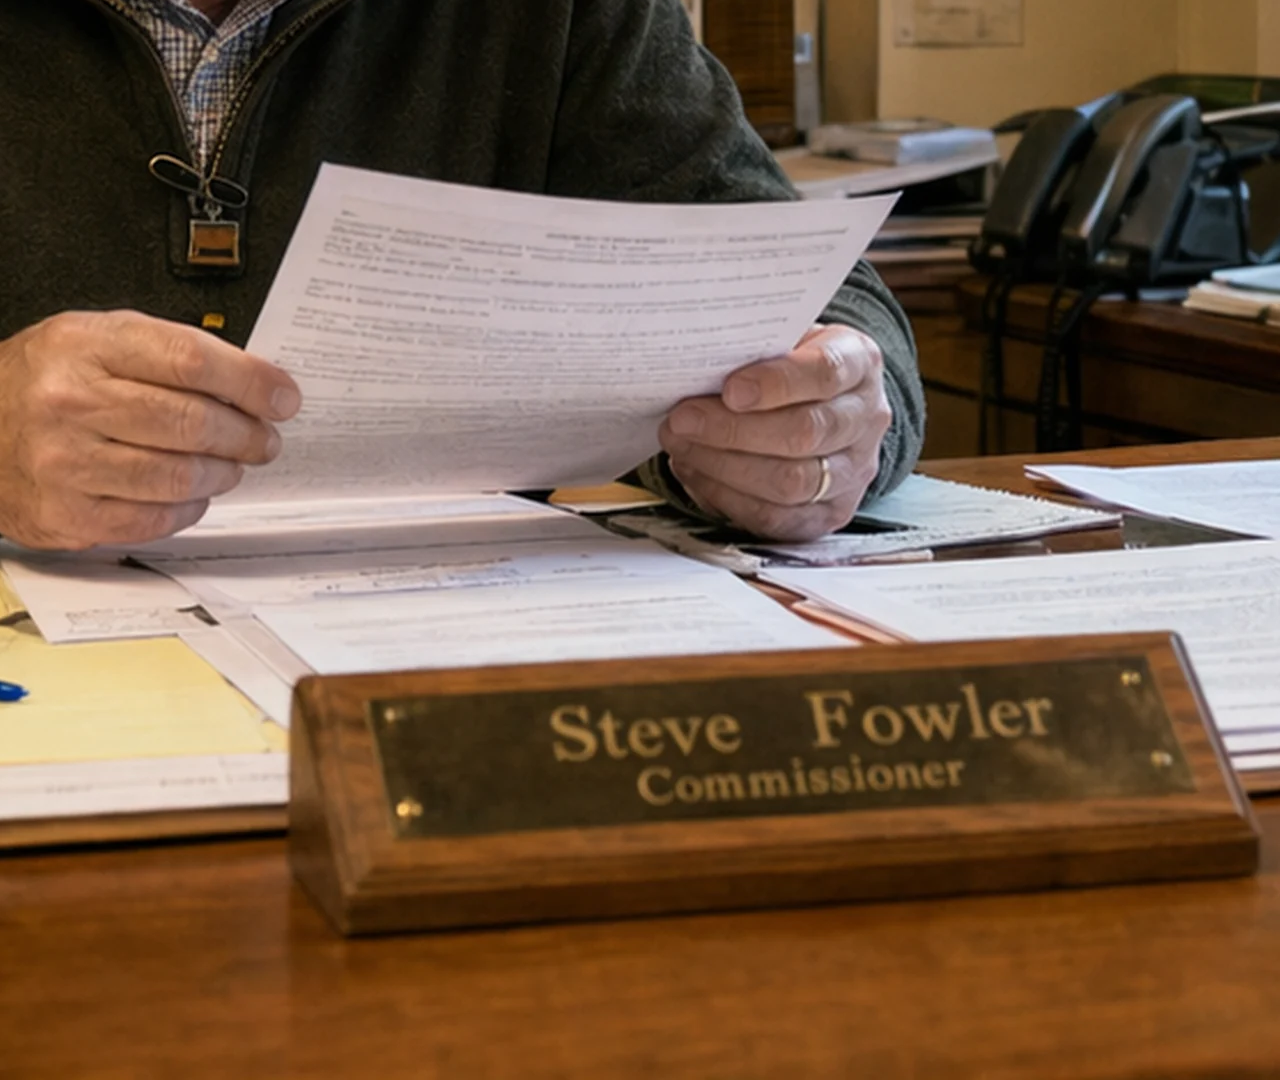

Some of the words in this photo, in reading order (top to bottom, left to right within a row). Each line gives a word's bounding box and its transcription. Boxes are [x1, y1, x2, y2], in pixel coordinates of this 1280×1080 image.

[549, 704, 742, 762] Steve
[803, 683, 1054, 749] Fowler
[636, 753, 966, 807] Commissioner
